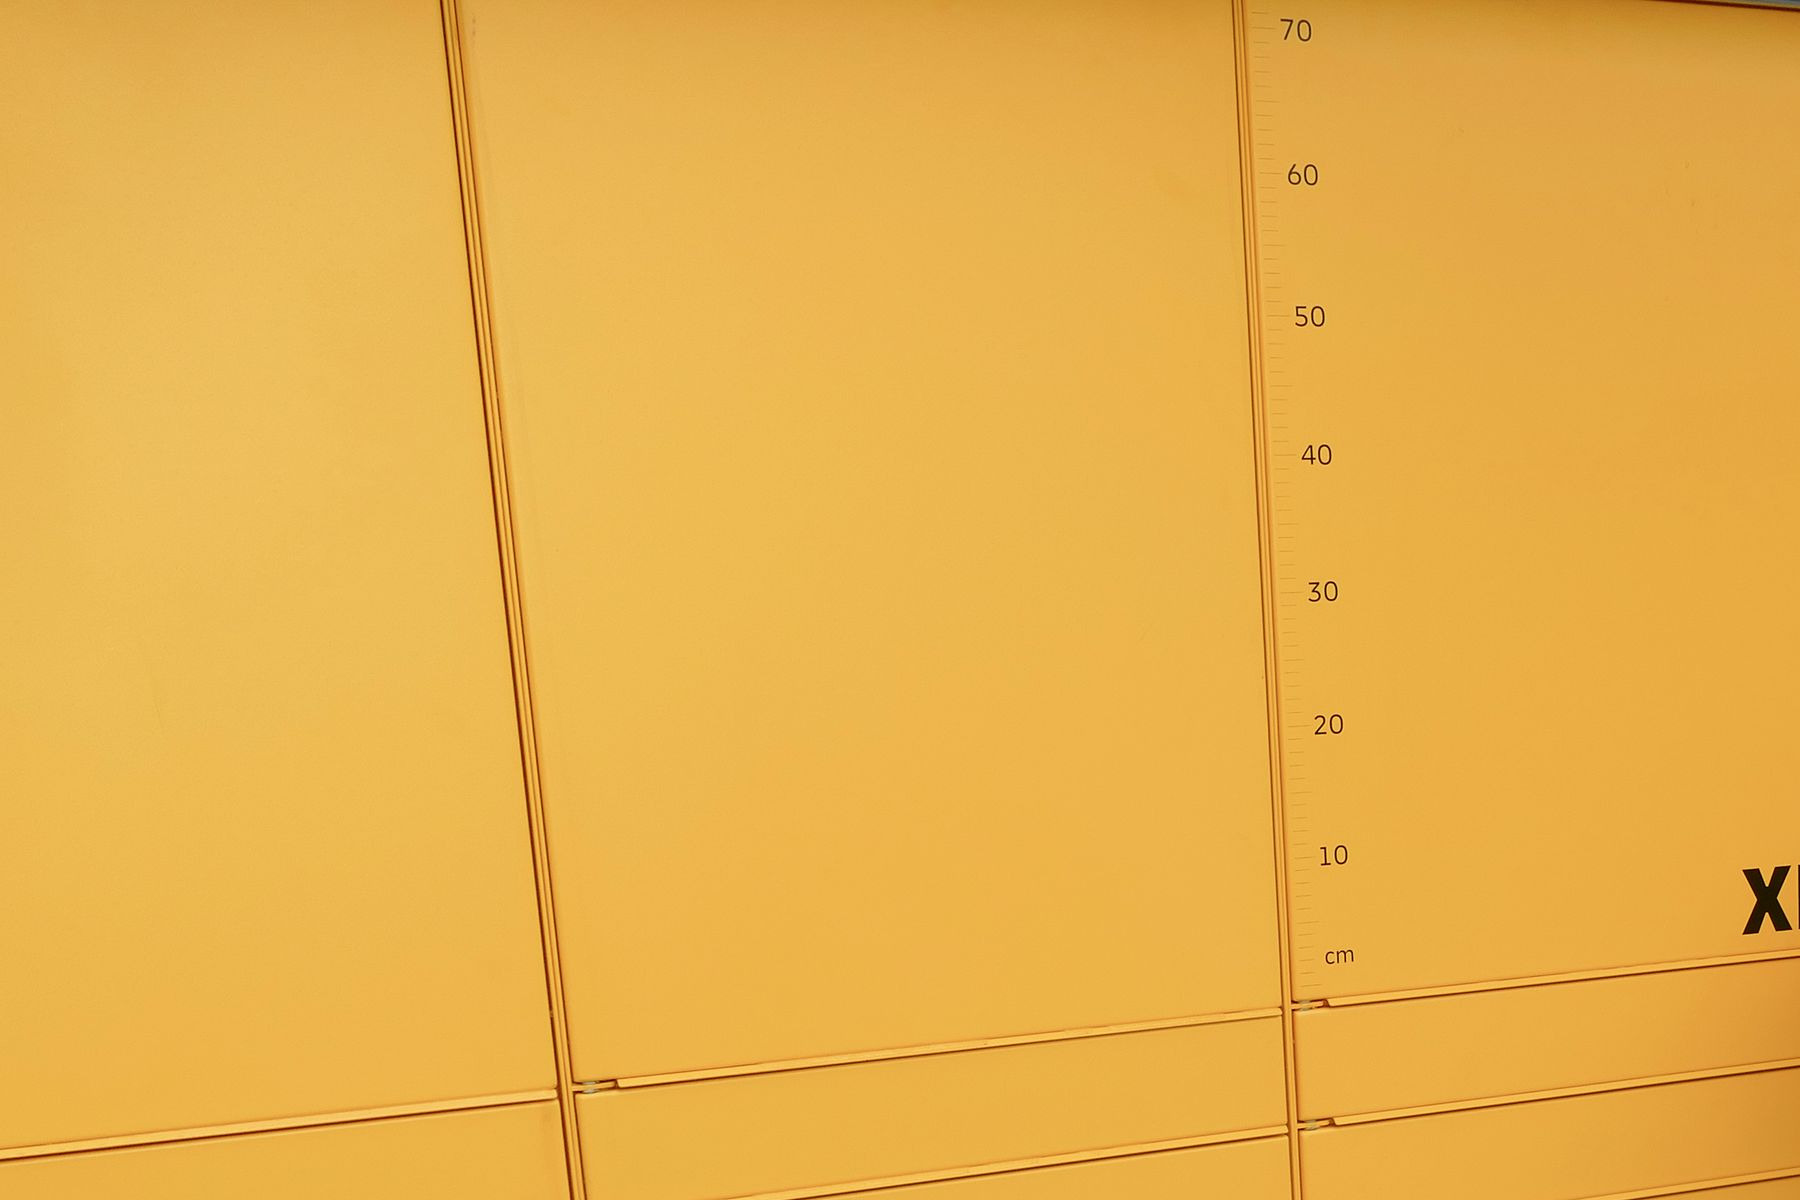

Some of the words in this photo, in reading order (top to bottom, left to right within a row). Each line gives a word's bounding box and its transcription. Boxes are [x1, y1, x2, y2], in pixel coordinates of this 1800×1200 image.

[1279, 18, 1312, 43] 70
[1287, 163, 1319, 186] 60
[1294, 305, 1326, 328] 50
[1301, 443, 1333, 466] 40
[1307, 580, 1339, 603] 30
[1313, 713, 1344, 736] 20
[1319, 844, 1349, 867] 10
[1324, 949, 1355, 965] cm
